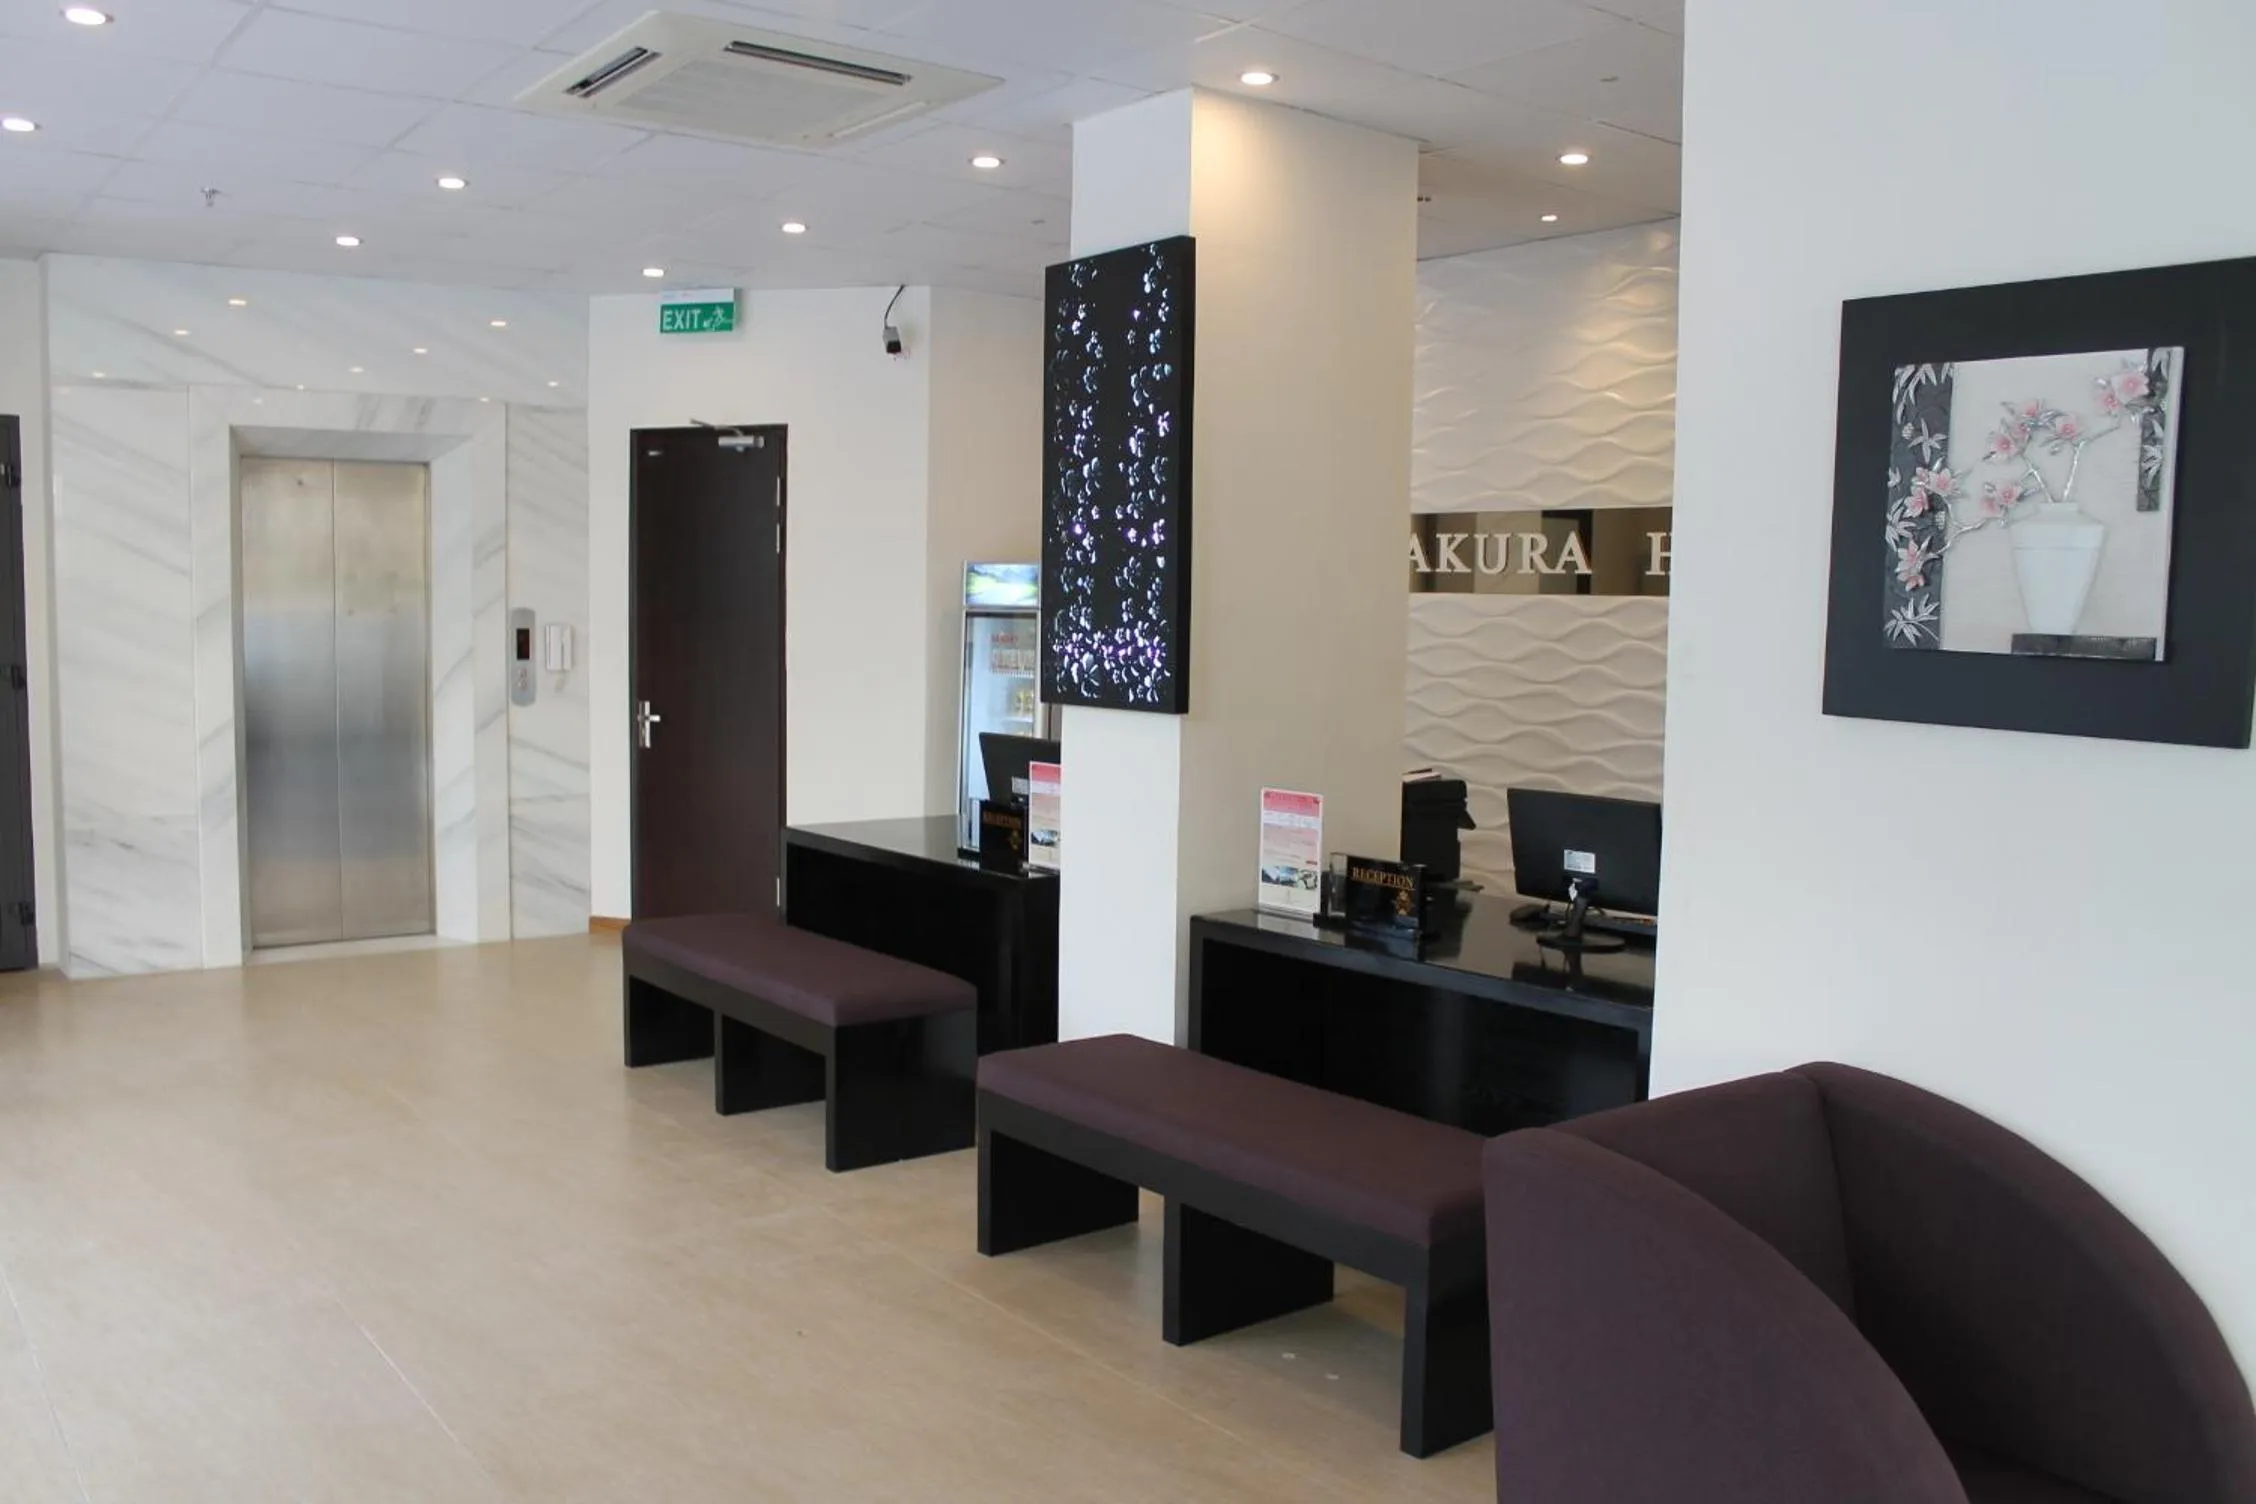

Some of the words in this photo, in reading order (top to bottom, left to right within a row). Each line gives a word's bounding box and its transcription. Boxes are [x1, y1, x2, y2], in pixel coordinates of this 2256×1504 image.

[663, 309, 702, 330] EXIT
[1408, 532, 1592, 575] AKURA
[1352, 866, 1415, 890] RECEPTION
